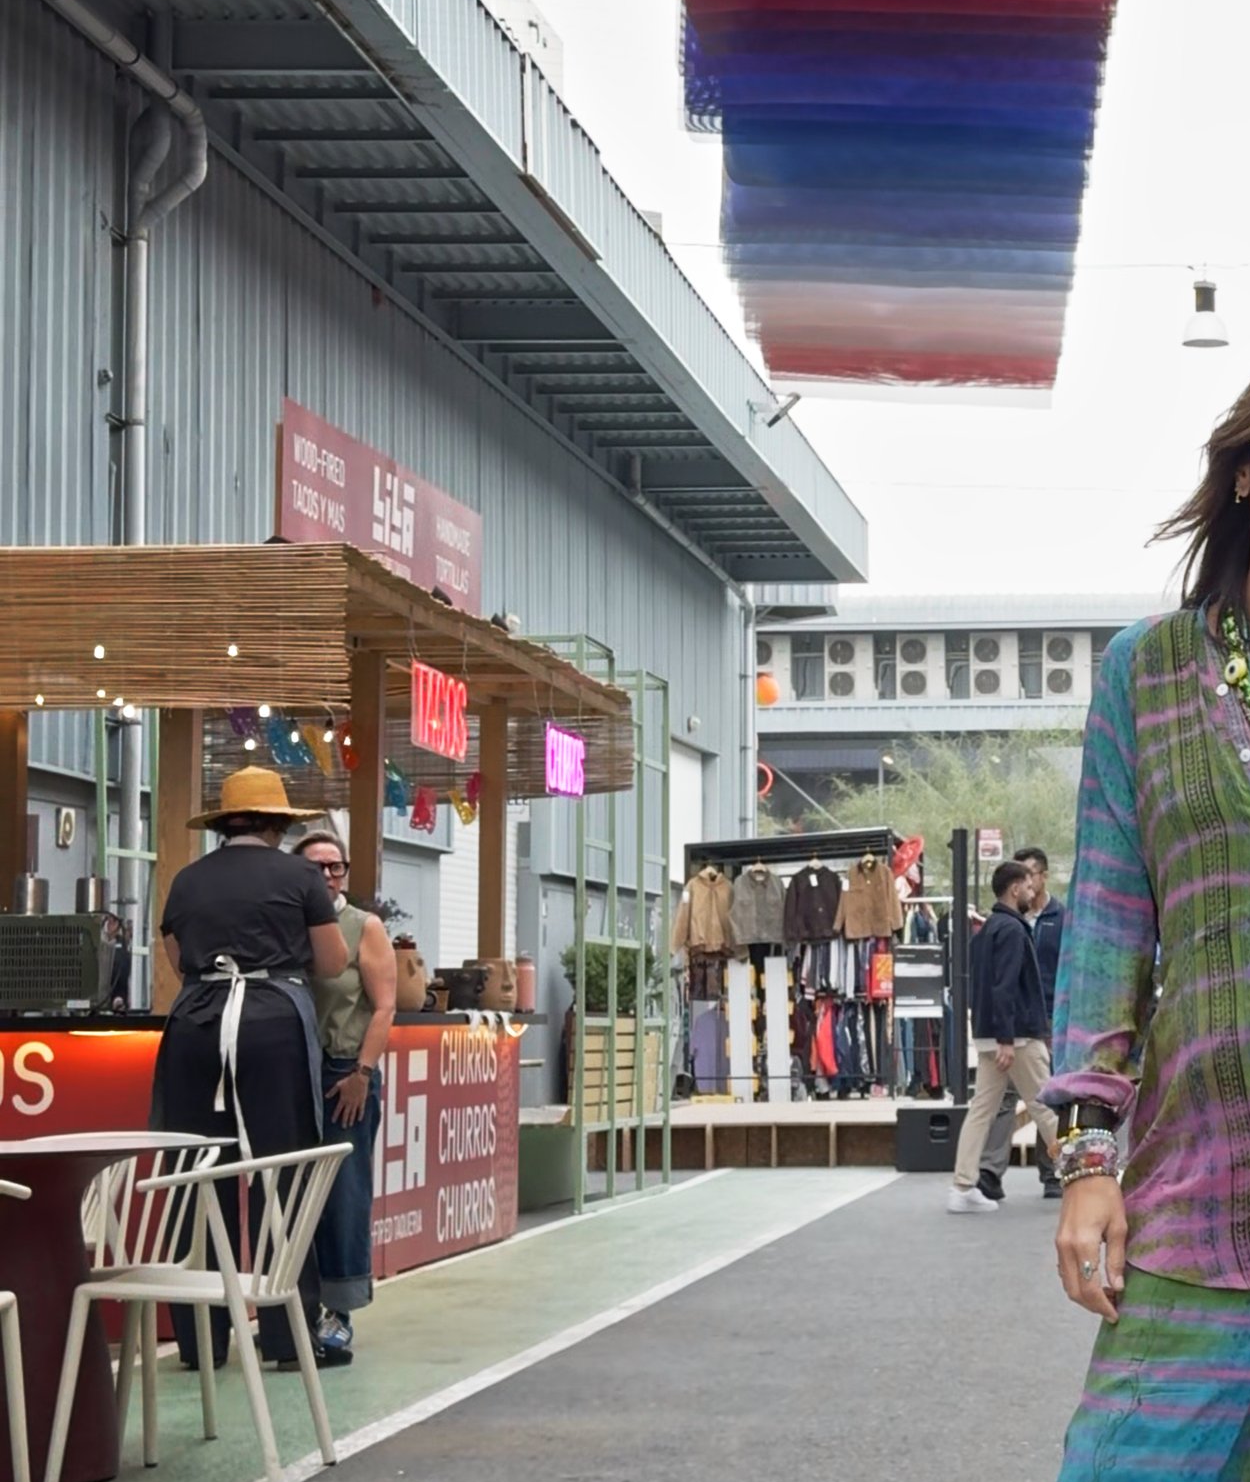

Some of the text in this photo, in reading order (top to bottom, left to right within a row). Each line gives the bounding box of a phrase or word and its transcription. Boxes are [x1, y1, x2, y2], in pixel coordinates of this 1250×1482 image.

[293, 433, 346, 488] WOOD-FIRED
[292, 480, 346, 533] TACOS Y MAS
[435, 554, 469, 595] TORTILLAS
[413, 660, 468, 758] TACOS
[0, 1040, 54, 1116] S
[440, 1030, 497, 1086] CHURROS
[438, 1103, 496, 1164] CHURROS
[437, 1176, 496, 1243] CHURROS
